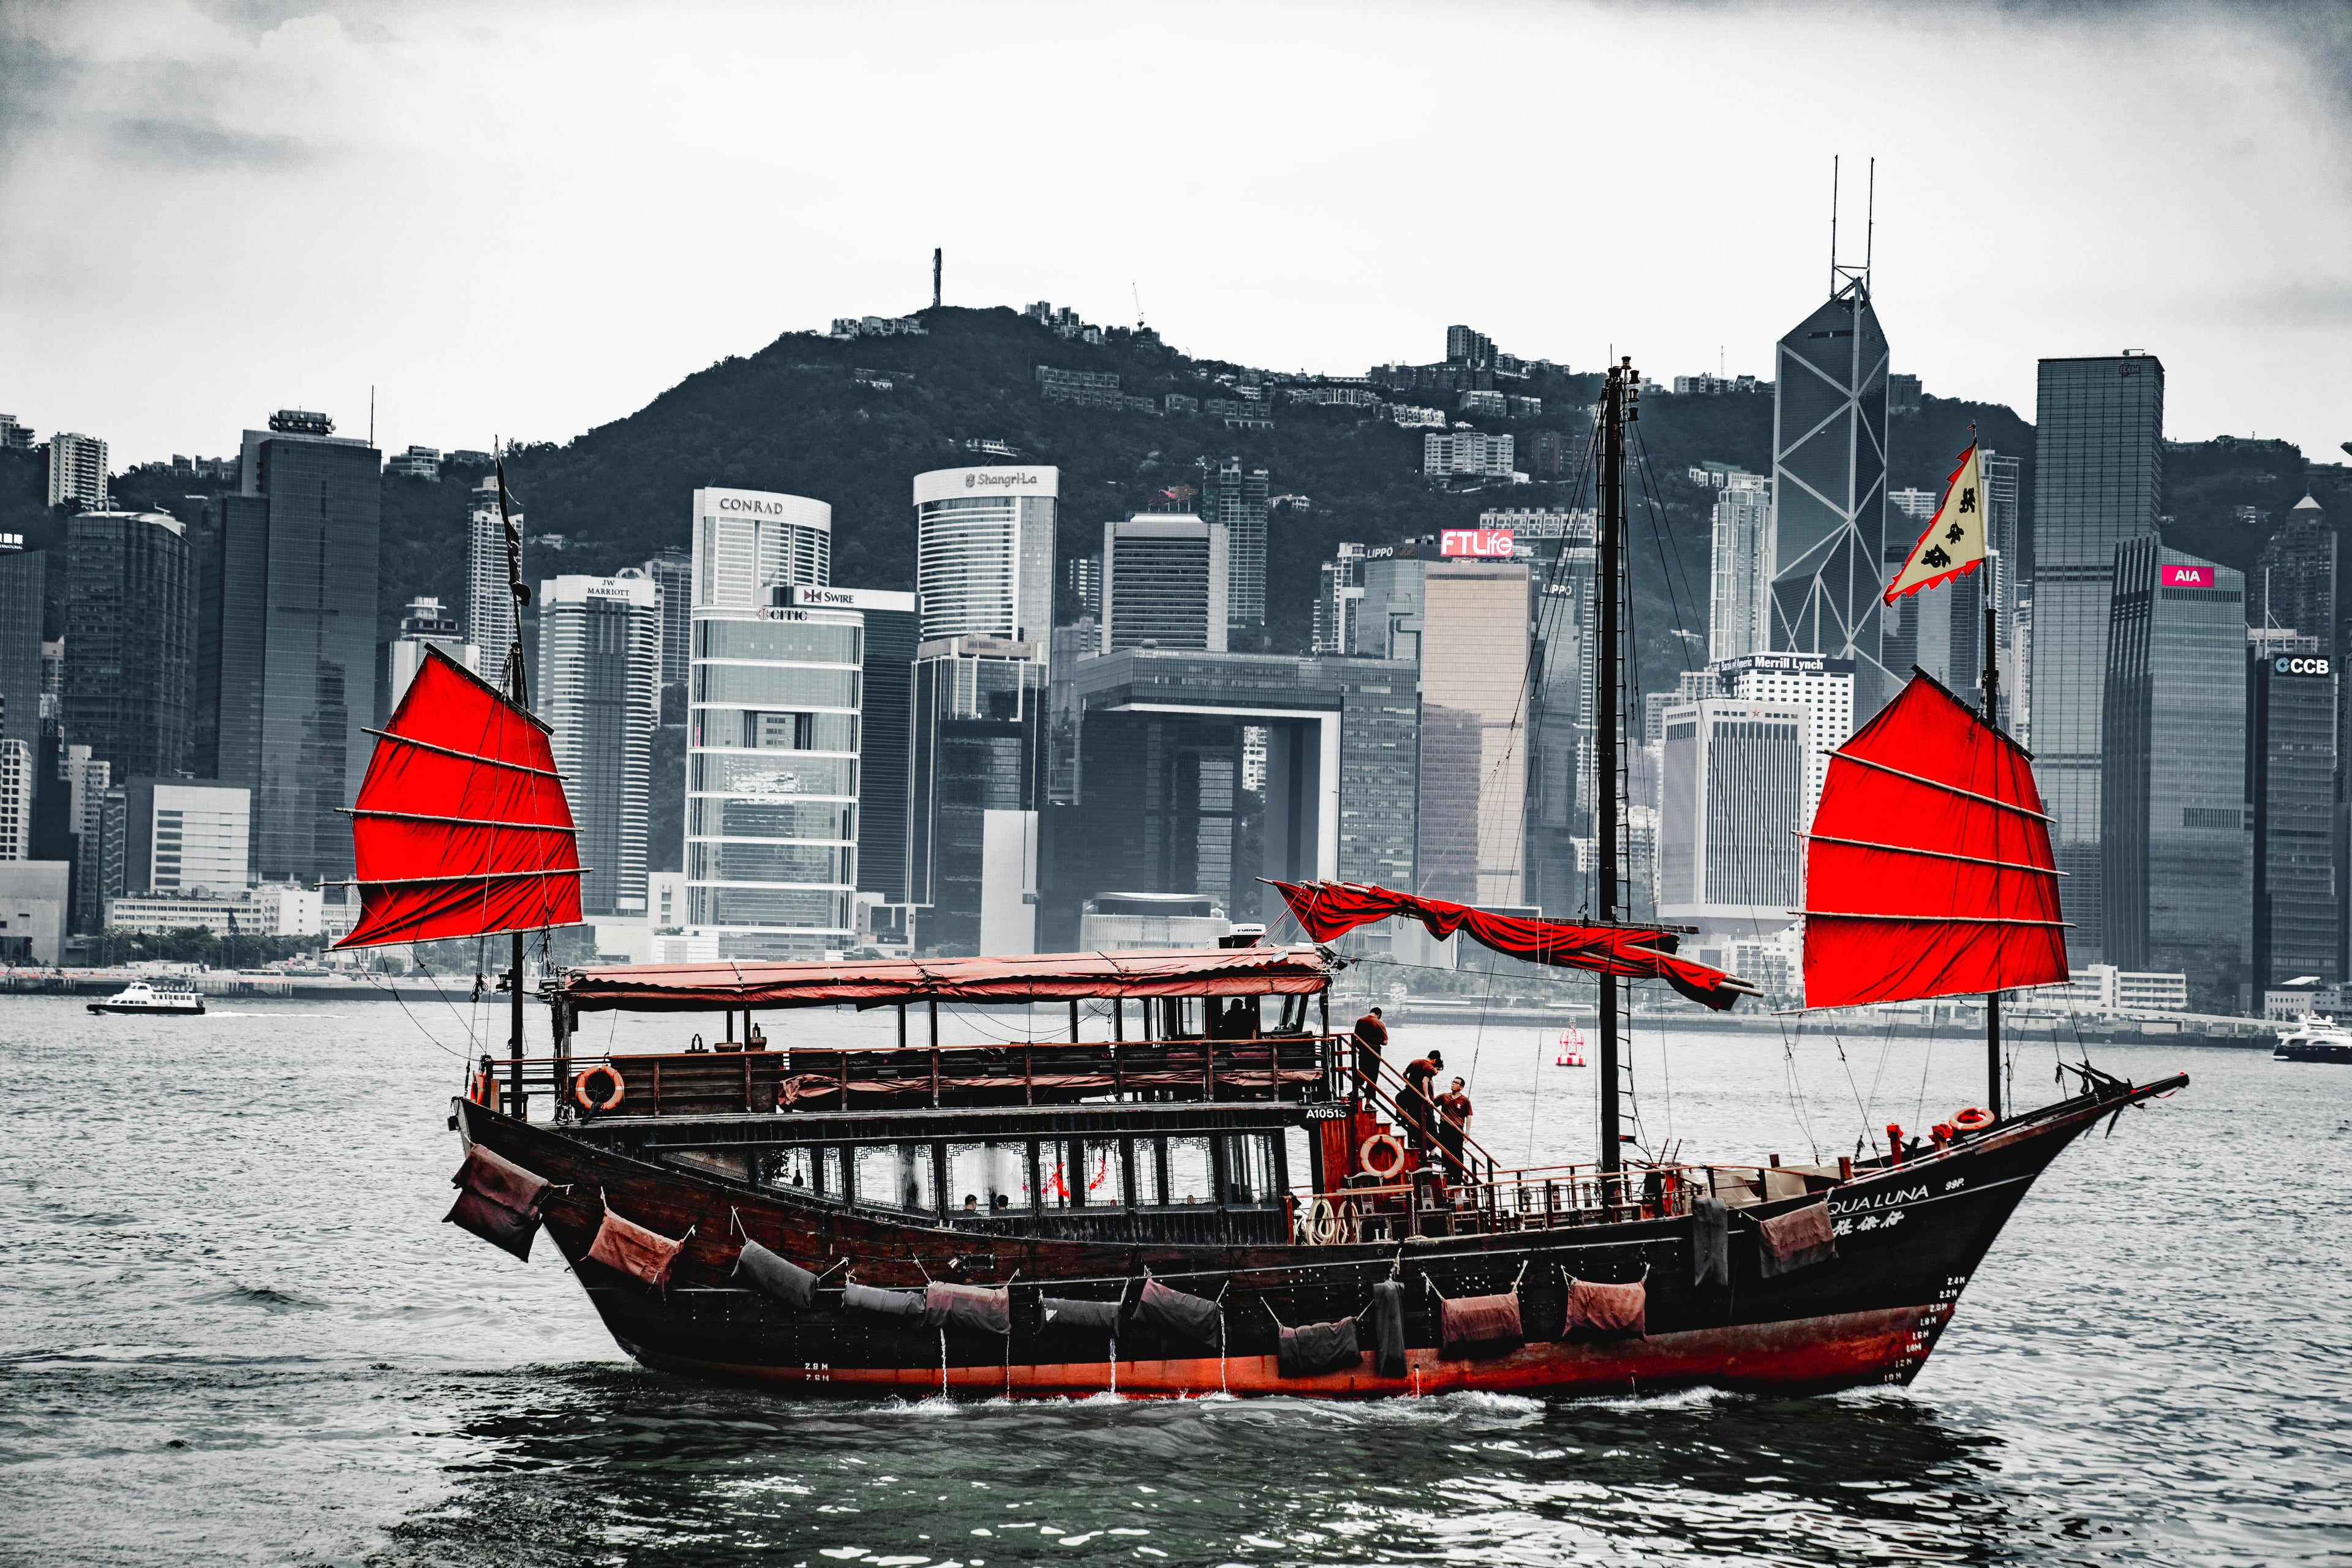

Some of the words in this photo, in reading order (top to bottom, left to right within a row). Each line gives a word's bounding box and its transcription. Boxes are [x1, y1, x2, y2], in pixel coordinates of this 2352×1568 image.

[977, 472, 1038, 488] Shangri-La
[720, 497, 783, 514] CONRAD
[1441, 531, 1513, 555] FTLife
[1366, 546, 1393, 559] LIPPO
[2174, 570, 2201, 582] AIA
[587, 587, 630, 596] MARRIOTT
[770, 609, 807, 621] CITIC
[1755, 656, 1790, 668] Merrill
[1792, 658, 1823, 671] Lynch
[2290, 658, 2329, 674] CCB
[1827, 1196, 1871, 1215] QUA
[1874, 1184, 1929, 1208] LUNA
